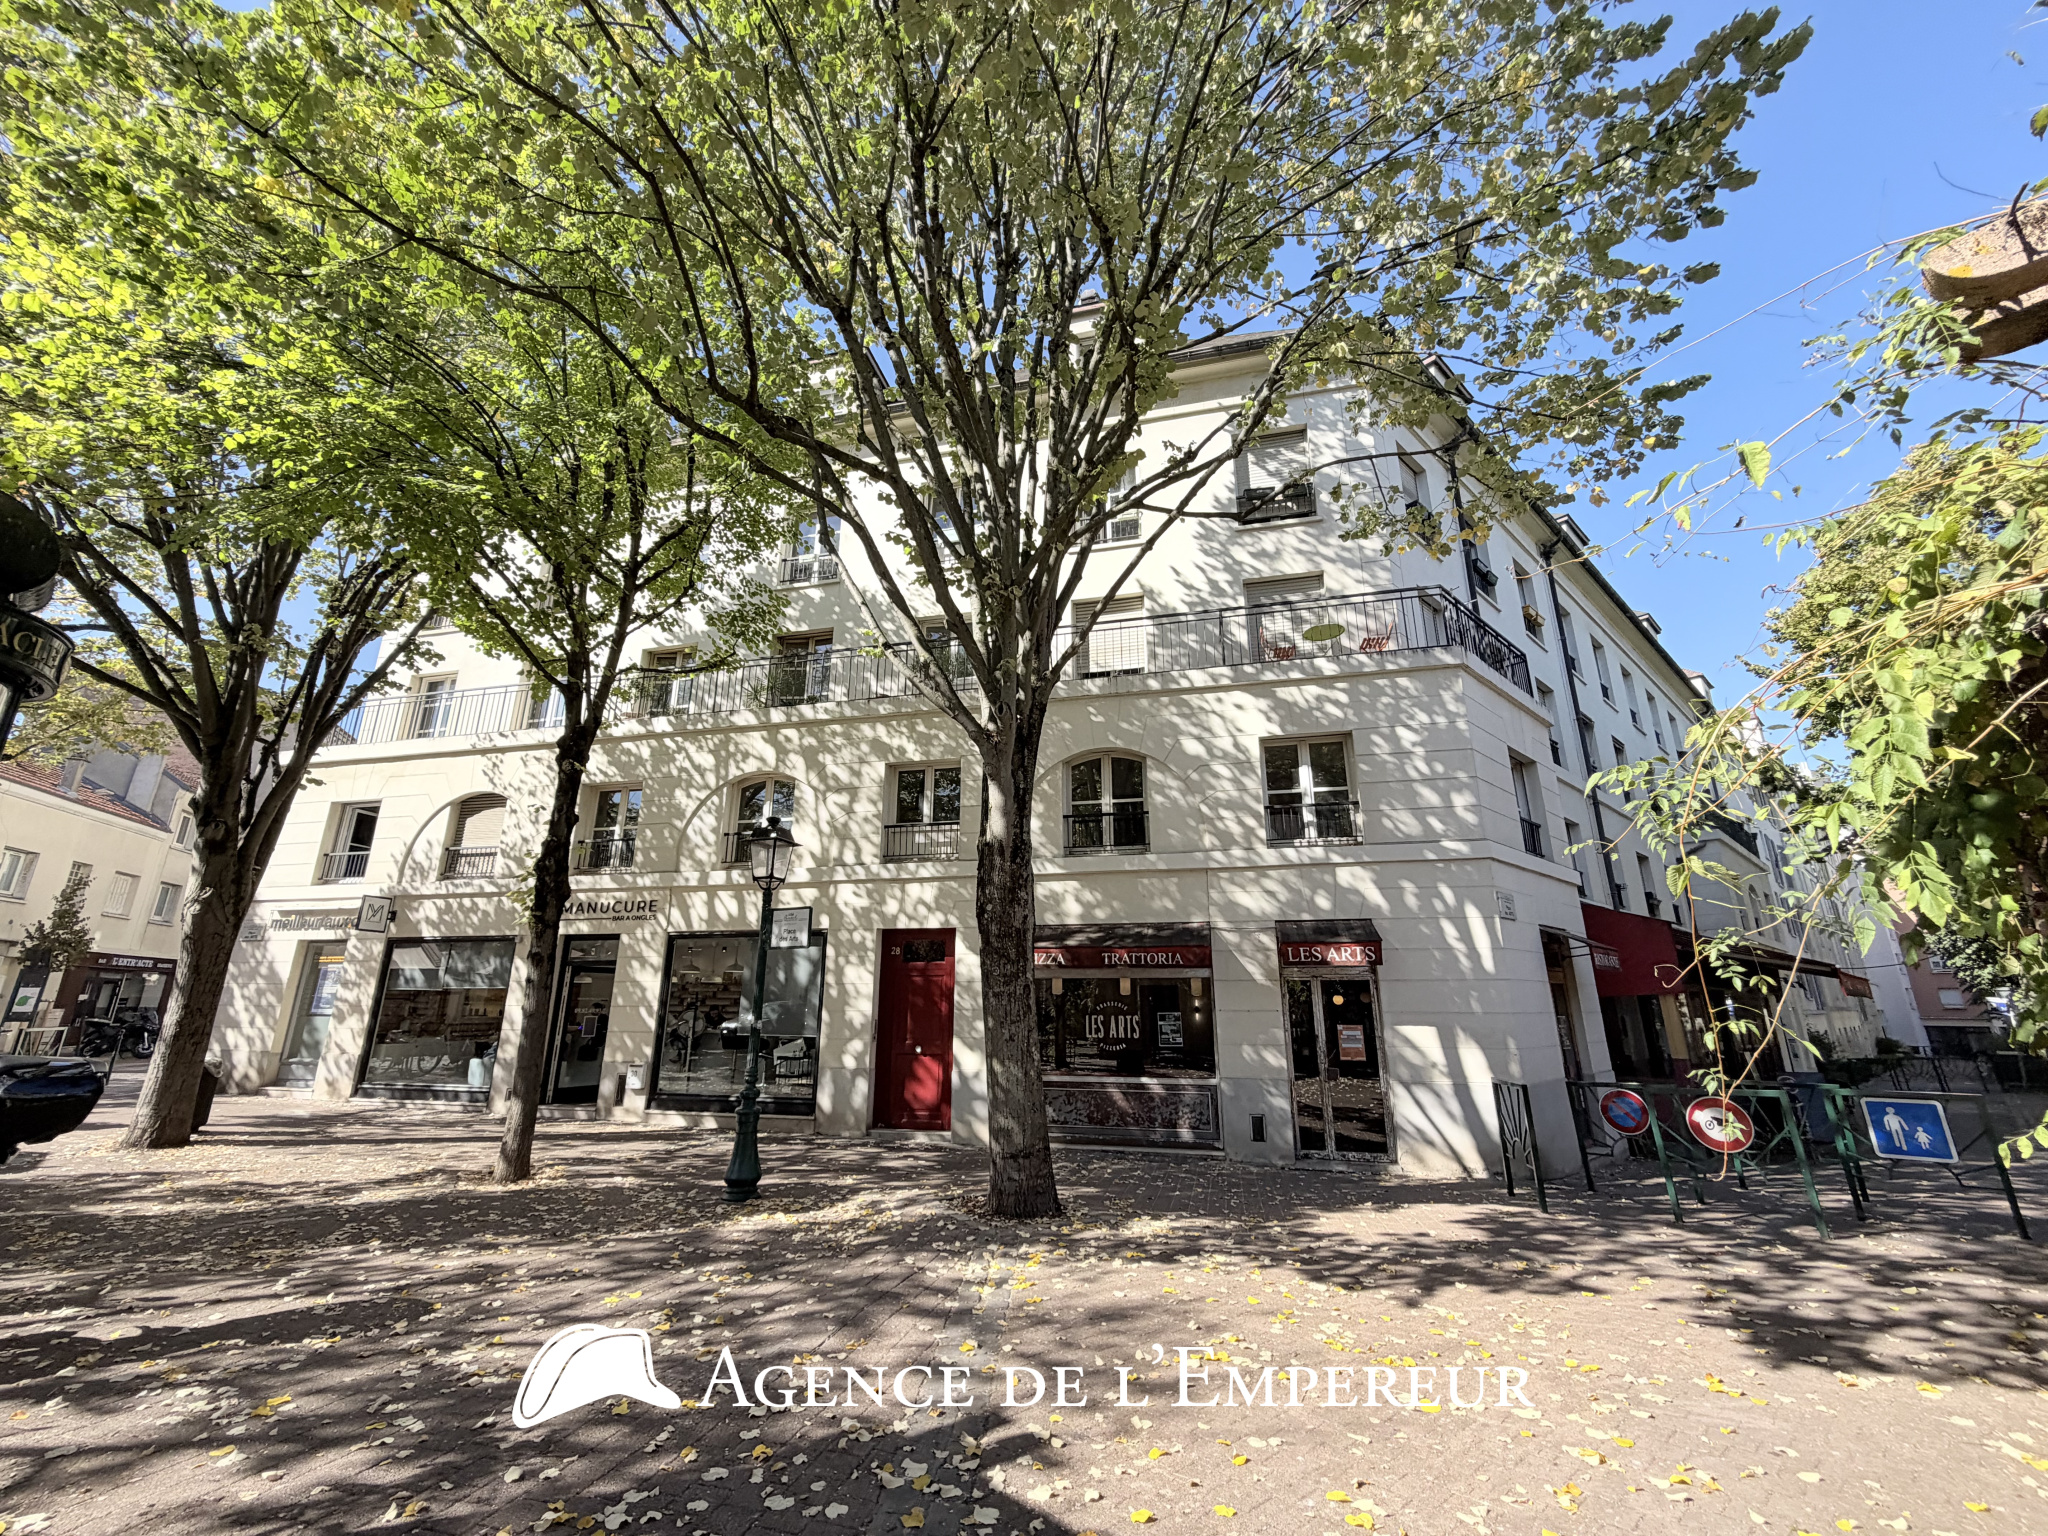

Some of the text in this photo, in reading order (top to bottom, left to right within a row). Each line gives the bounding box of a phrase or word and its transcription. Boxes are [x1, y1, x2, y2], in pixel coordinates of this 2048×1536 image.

[562, 900, 658, 914] MANUCURE
[890, 946, 901, 955] 28
[1287, 946, 1376, 962] LES ARTS
[1034, 952, 1184, 965] IZZA TRATTORIA
[1096, 1001, 1128, 1011] BRASSERIE
[1085, 1014, 1105, 1039] LES
[1109, 1014, 1140, 1039] ARTS
[1100, 1042, 1127, 1051] PIZZERIA
